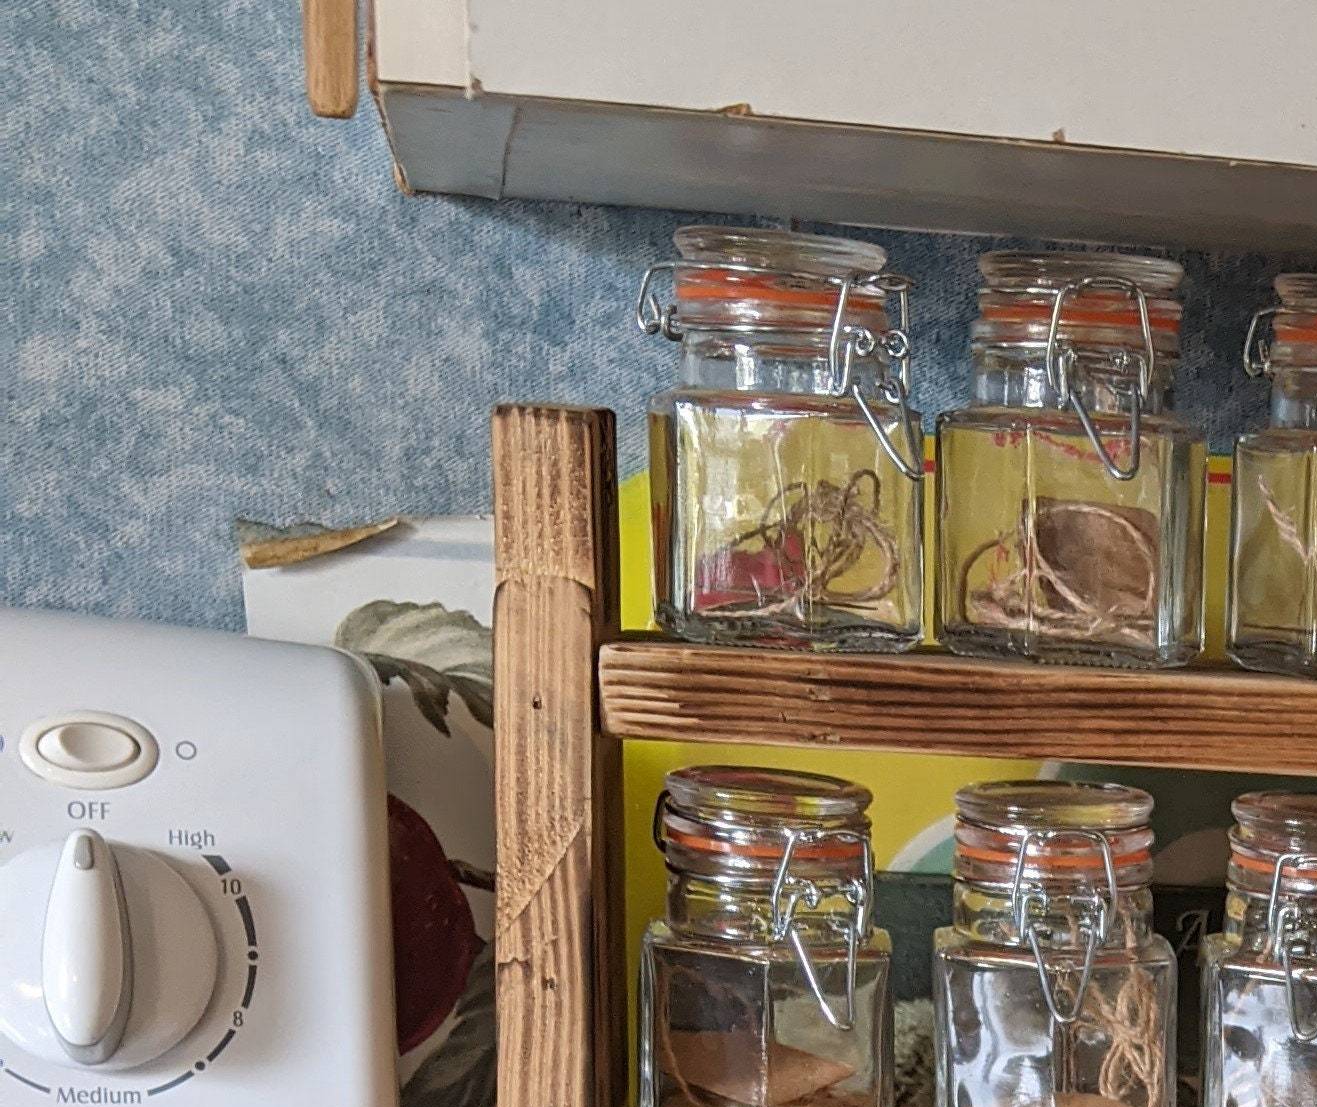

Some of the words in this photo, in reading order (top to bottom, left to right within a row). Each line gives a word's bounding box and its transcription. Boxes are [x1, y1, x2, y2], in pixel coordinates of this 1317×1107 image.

[67, 801, 111, 820] OFF
[168, 829, 215, 850] High
[220, 878, 242, 895] 10
[232, 1010, 244, 1027] 8
[56, 1086, 142, 1104] Medium
